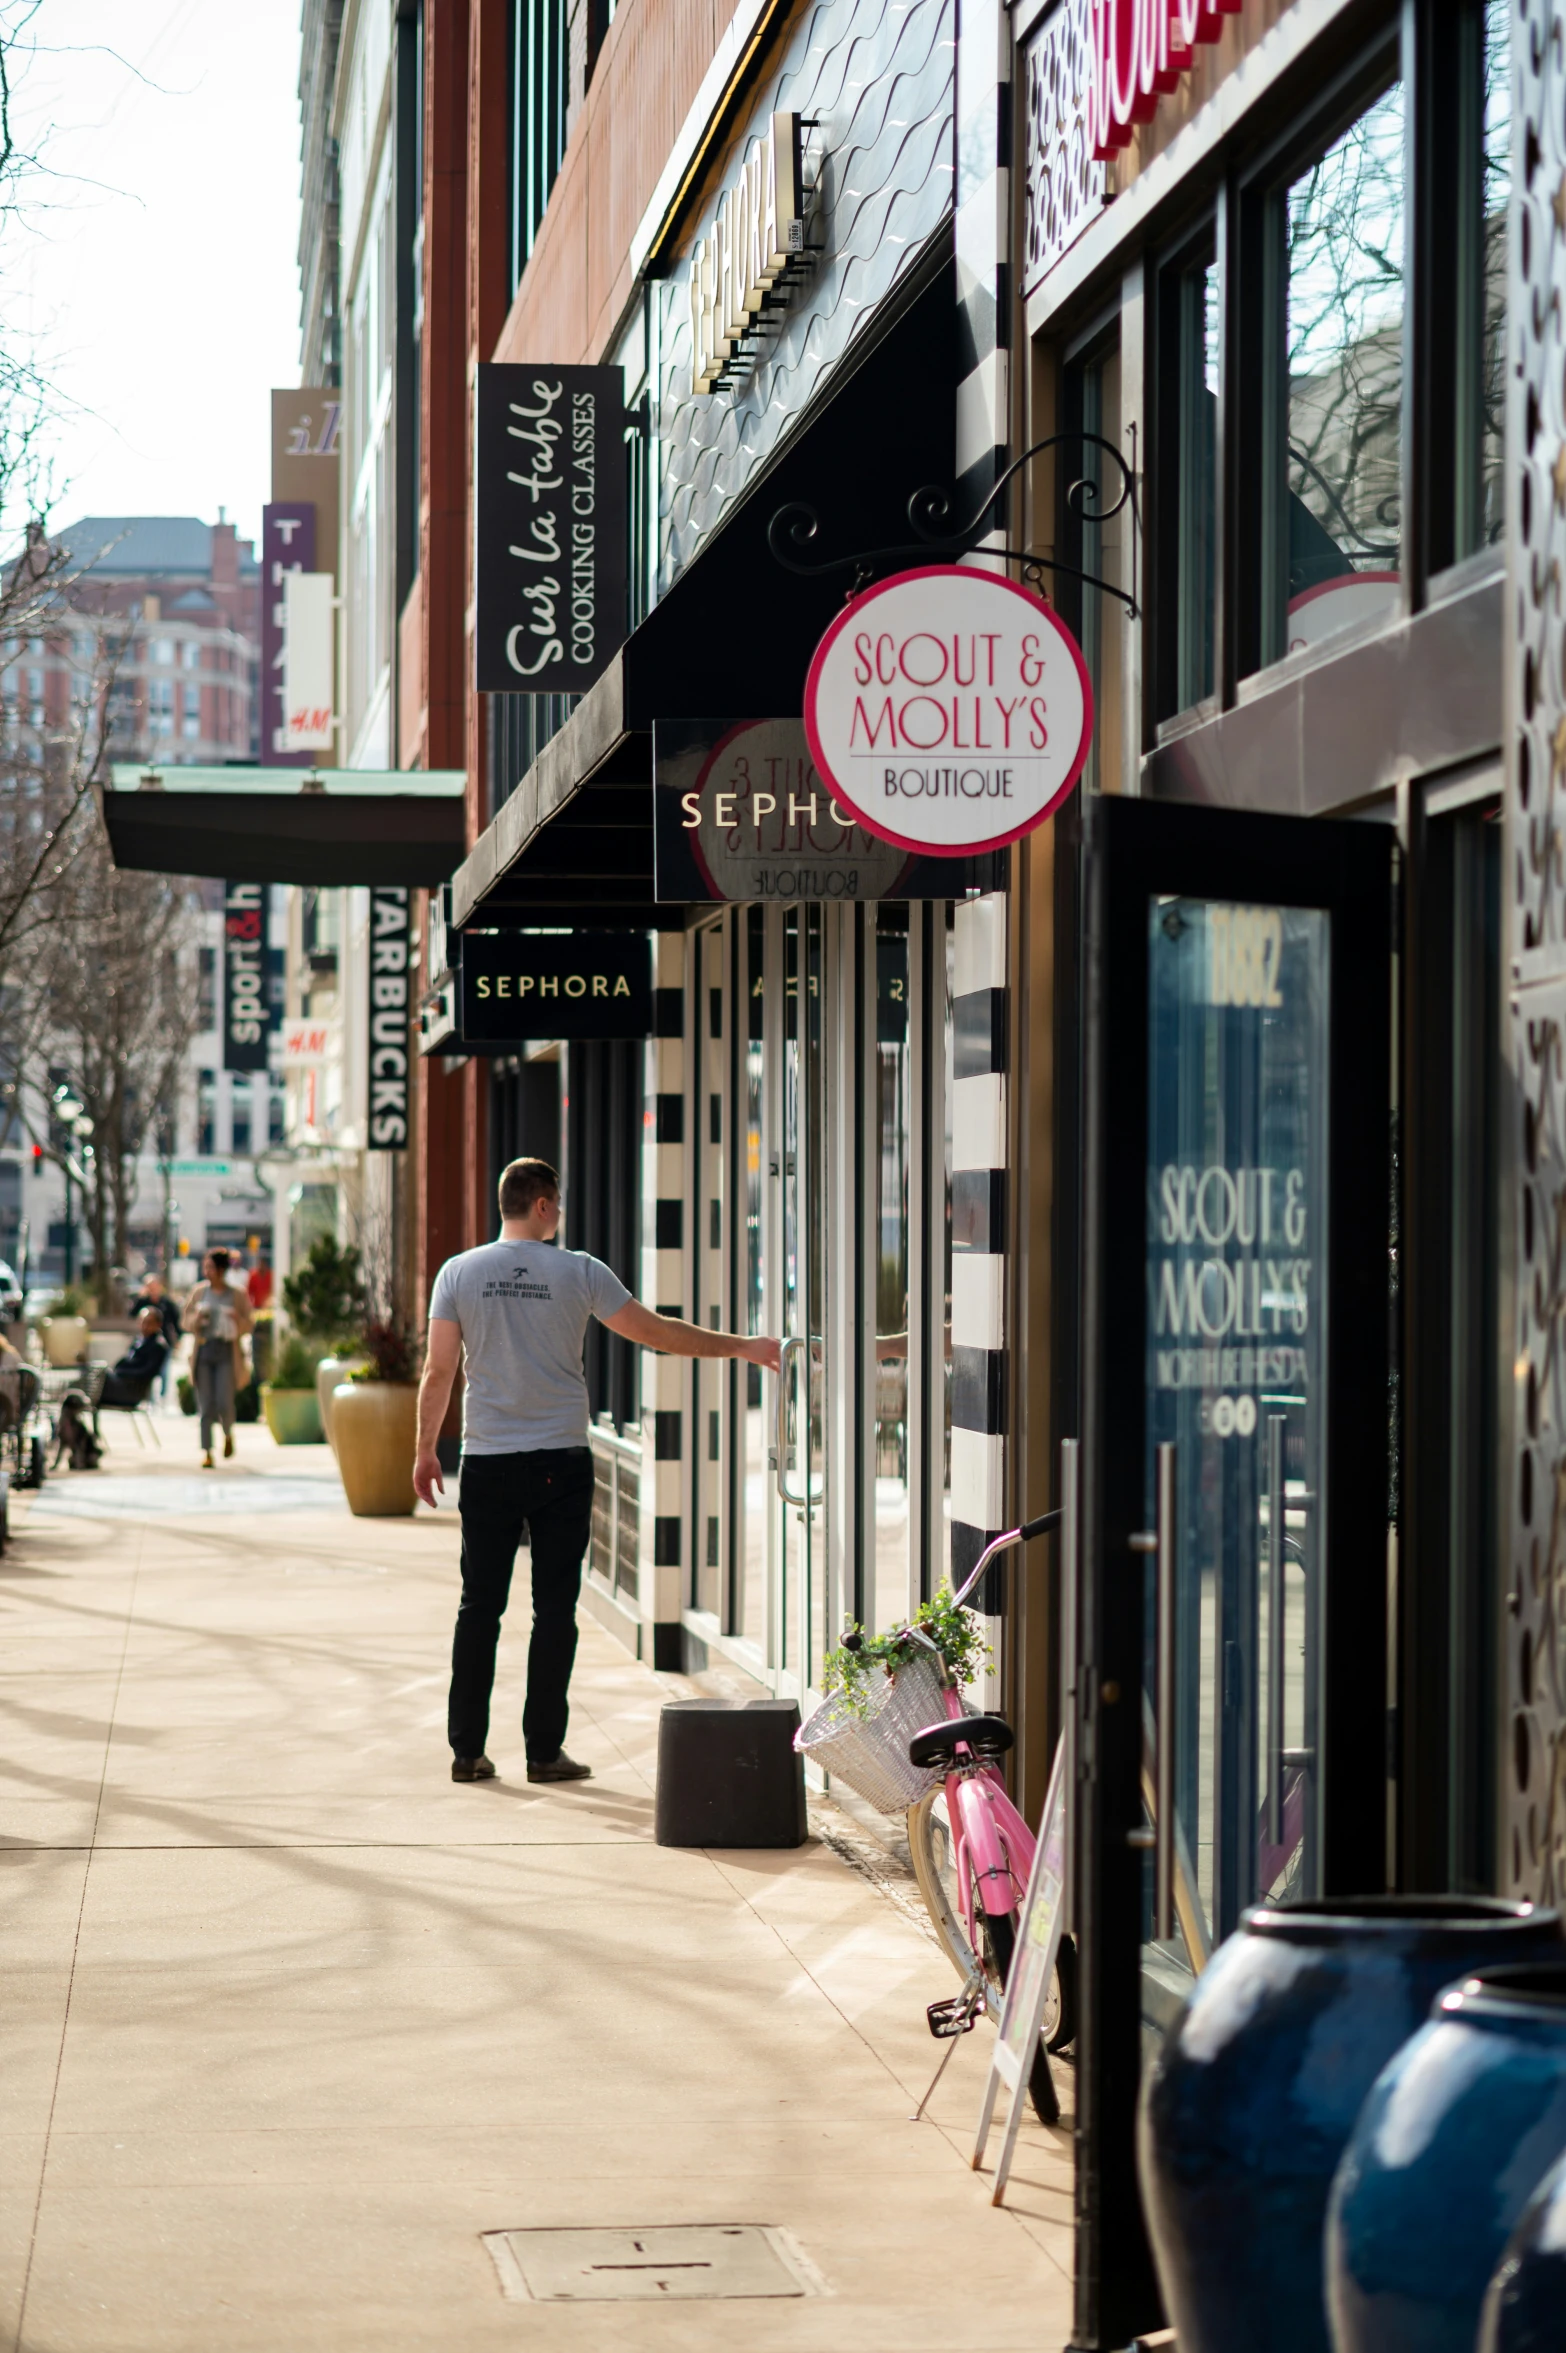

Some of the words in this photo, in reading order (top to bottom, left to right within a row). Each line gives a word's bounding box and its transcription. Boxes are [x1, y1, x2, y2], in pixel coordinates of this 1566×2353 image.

[506, 380, 564, 503] table
[571, 392, 595, 516] CLASSES
[508, 511, 562, 562] la
[571, 523, 595, 664] COOKING
[506, 576, 564, 675] Sur
[854, 632, 1003, 687] SCOUT
[1019, 634, 1047, 687] &
[849, 695, 1048, 750] MOLLY'S
[884, 768, 1014, 798] BOUTIQUE
[477, 975, 632, 999] SEPHORA
[1160, 1163, 1277, 1246] SCOUT
[1284, 1167, 1308, 1247] &
[482, 1290, 493, 1299] THE
[495, 1289, 520, 1298] PERFECT
[486, 1281, 496, 1289] THE
[498, 1281, 512, 1289] BEST
